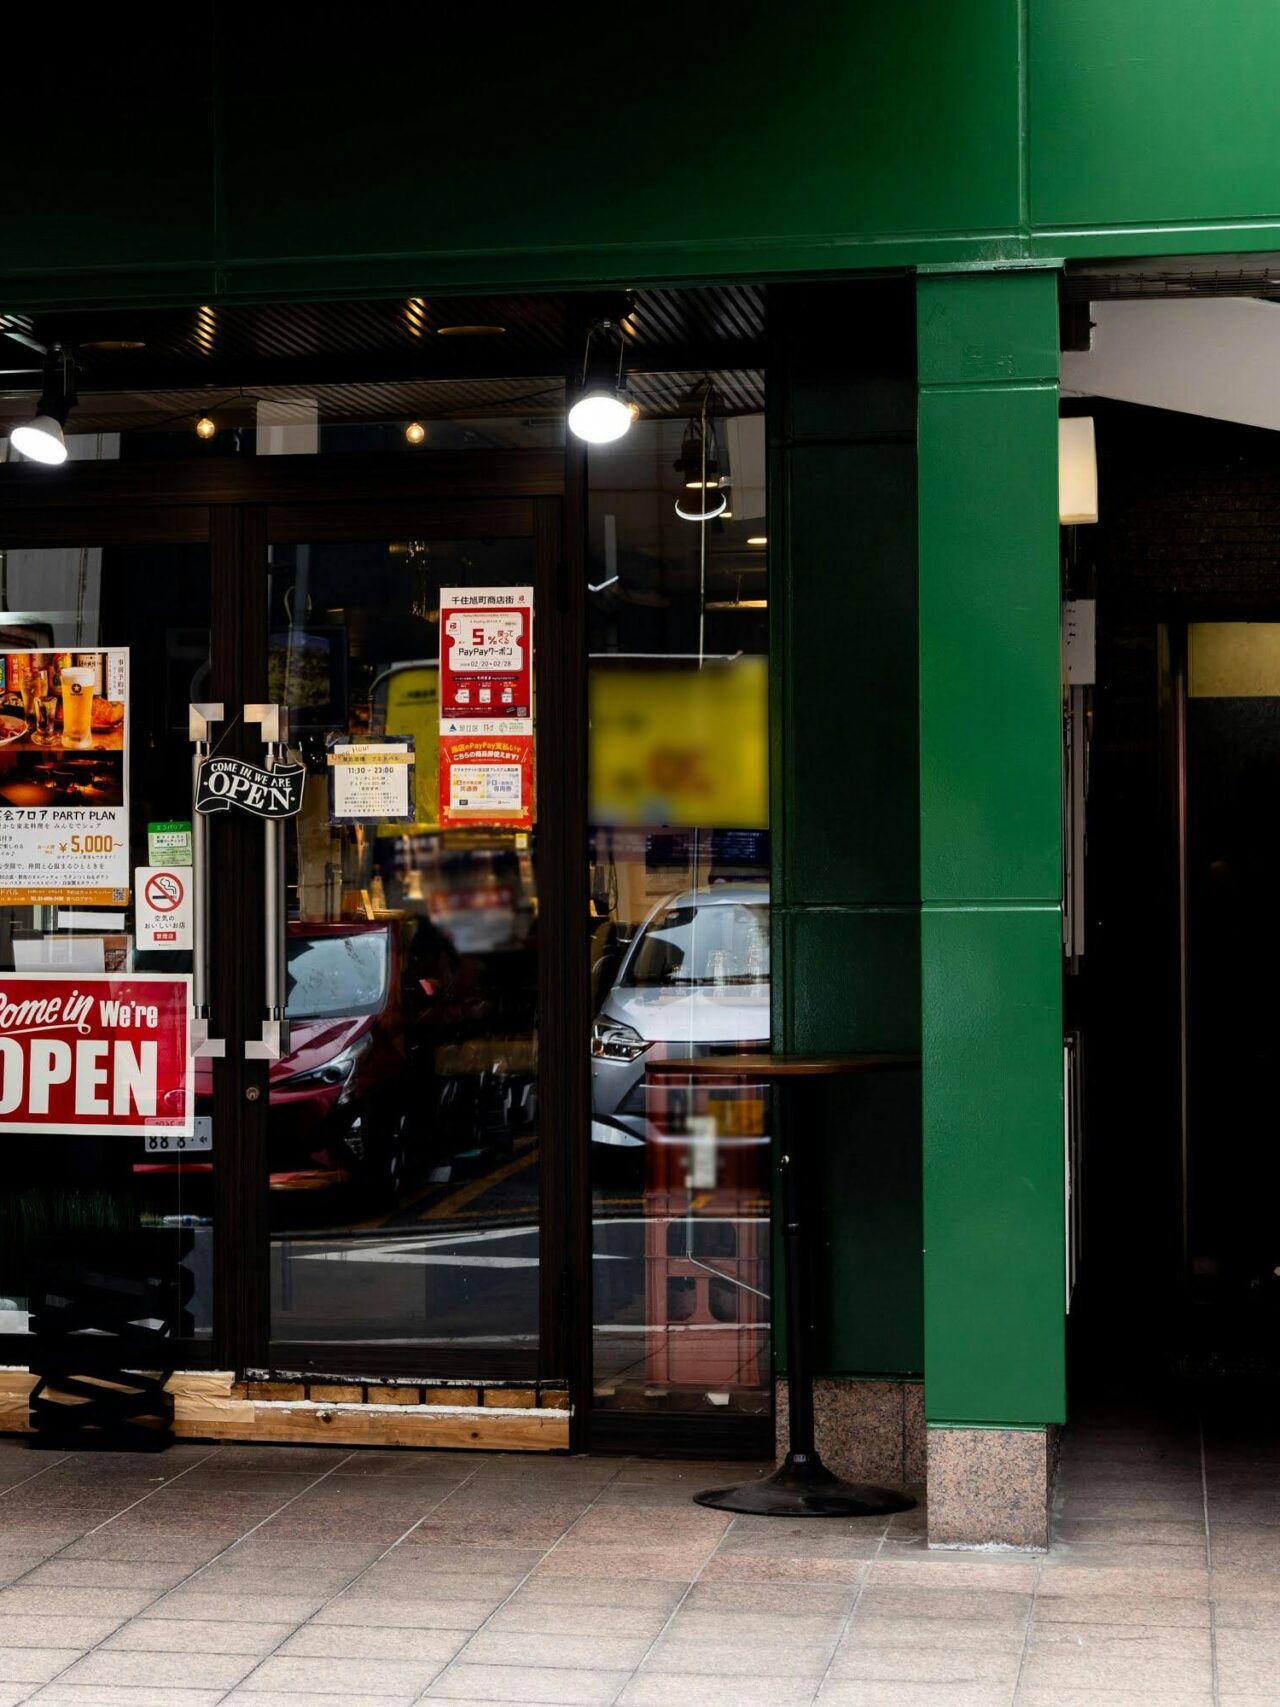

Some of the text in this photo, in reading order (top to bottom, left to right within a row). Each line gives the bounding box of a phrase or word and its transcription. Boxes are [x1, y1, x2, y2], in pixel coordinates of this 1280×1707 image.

[452, 596, 514, 605] 千住旭町商店街
[459, 648, 513, 656] PayPayクーポン
[211, 763, 238, 772] COME
[255, 773, 268, 785] WE
[271, 778, 291, 787] ARE
[208, 772, 293, 810] OPEN
[53, 811, 86, 820] PARTY
[89, 811, 115, 820] PLAN
[63, 990, 94, 1034] in
[100, 1000, 158, 1028] We're
